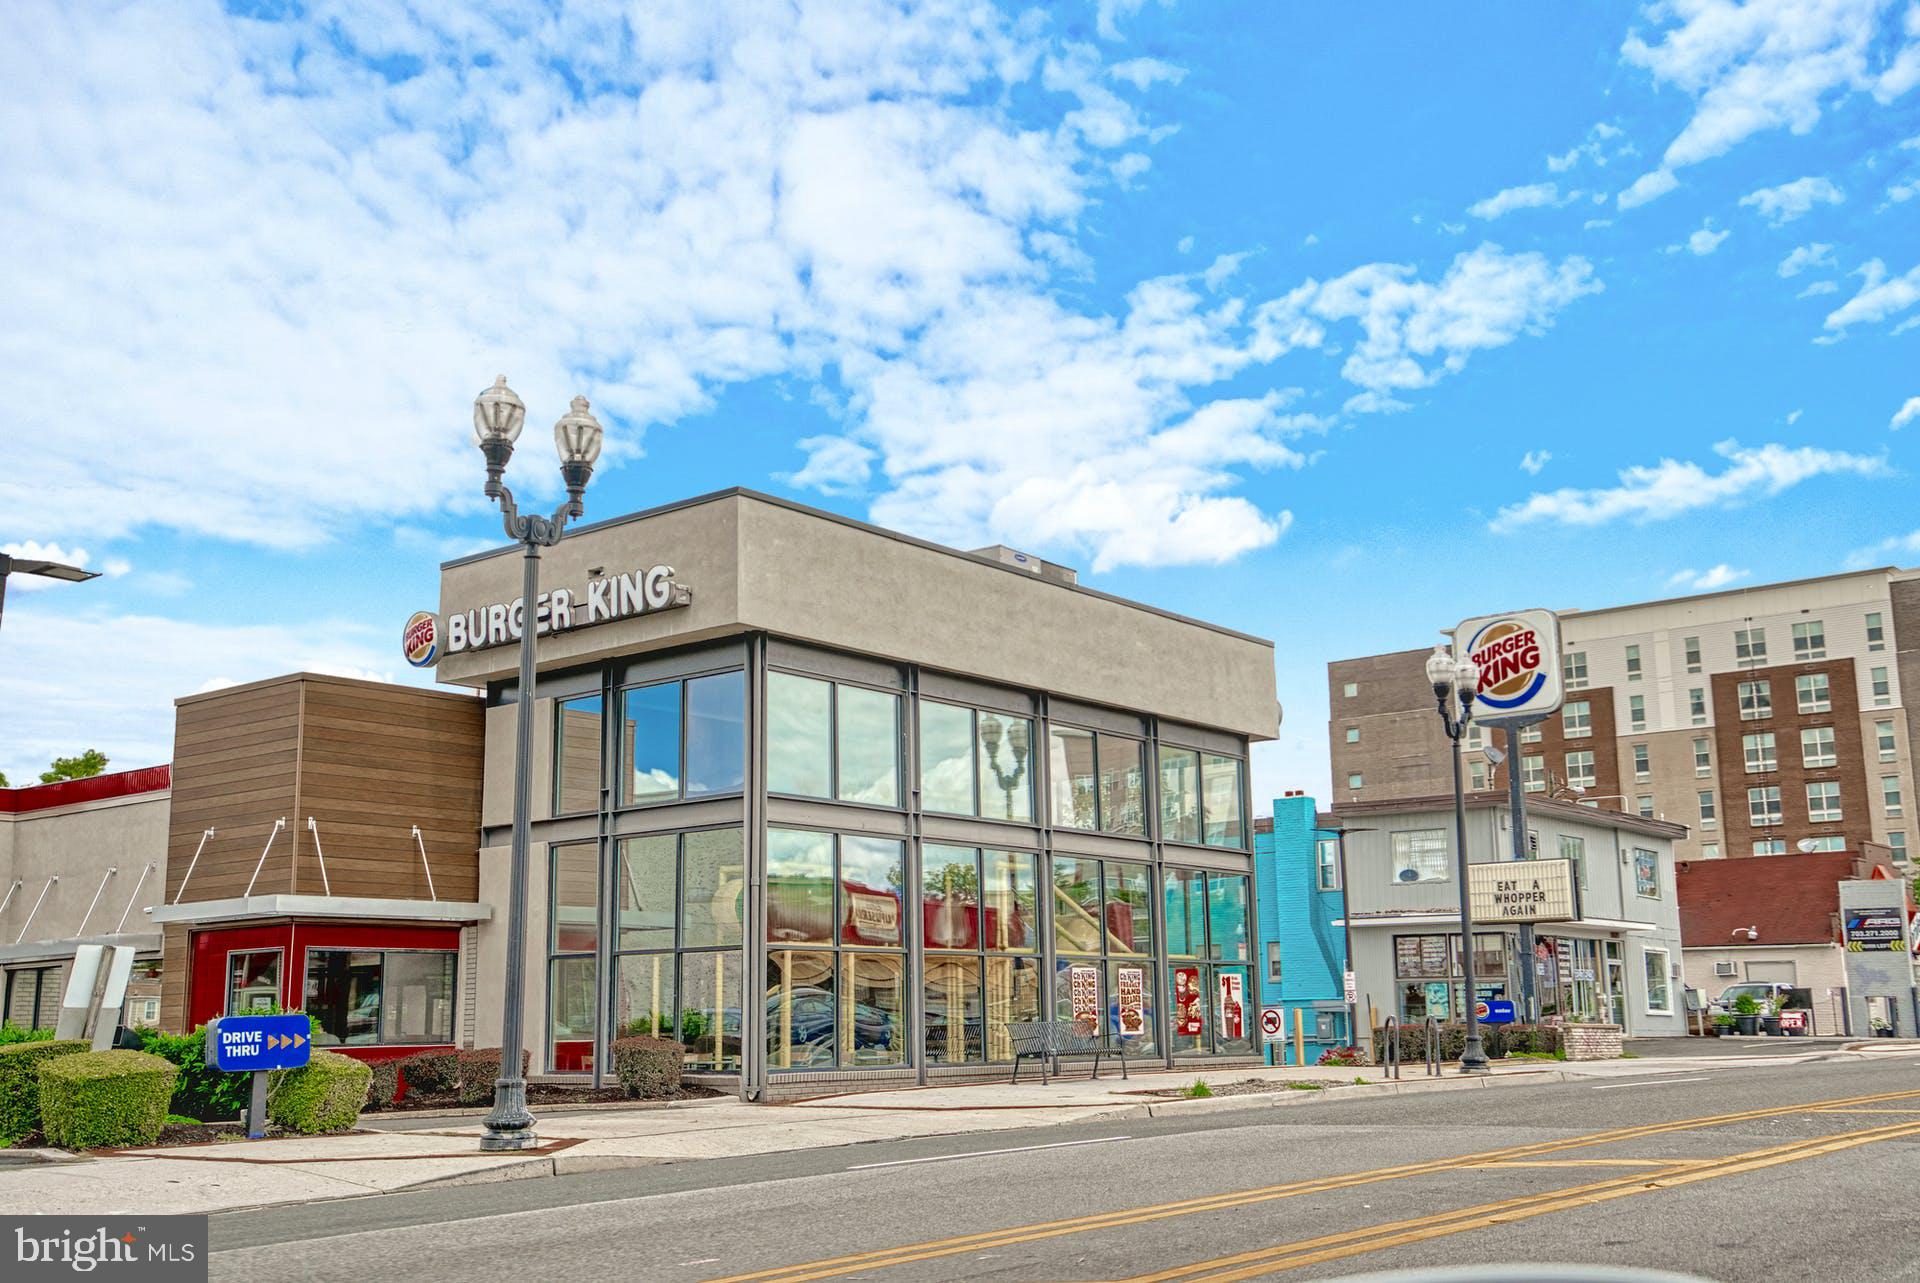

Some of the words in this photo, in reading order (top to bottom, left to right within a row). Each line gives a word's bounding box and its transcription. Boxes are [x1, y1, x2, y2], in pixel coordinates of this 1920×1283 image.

[449, 588, 573, 651] BURGER
[587, 564, 672, 622] KING
[405, 618, 433, 641] BURGER
[406, 627, 433, 657] KING
[1477, 645, 1540, 694] KING
[1497, 880, 1517, 891] EAT
[1532, 879, 1540, 890] A
[1494, 891, 1546, 904] WHOPPER
[1502, 904, 1537, 916] AGAIN
[222, 1031, 263, 1044] DRIVE
[225, 1044, 260, 1057] THRU
